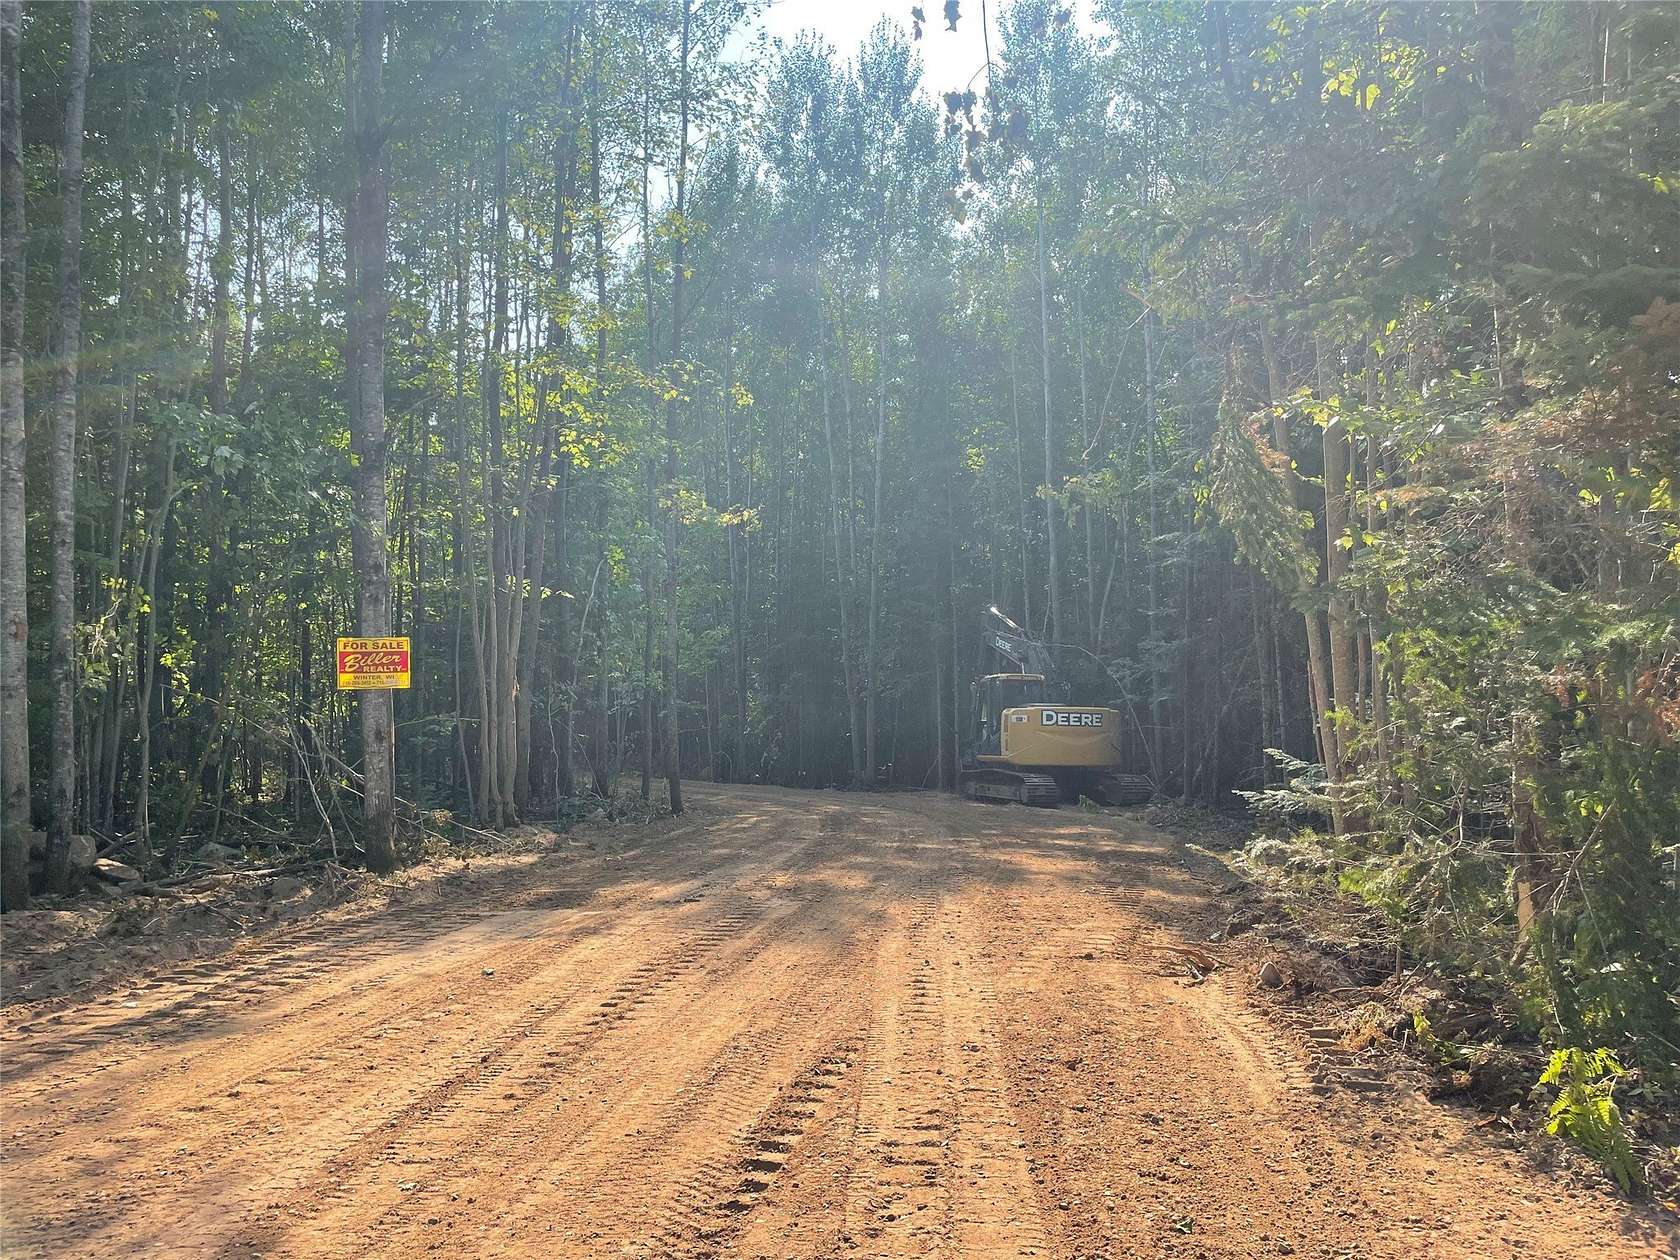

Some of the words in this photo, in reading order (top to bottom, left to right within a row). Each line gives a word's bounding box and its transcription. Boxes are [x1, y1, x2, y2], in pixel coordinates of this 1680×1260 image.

[343, 642, 368, 650] FOR
[372, 641, 404, 650] SALE
[995, 636, 1012, 652] DEERE
[343, 652, 401, 672] Biller
[363, 665, 402, 673] REALTY
[1042, 710, 1102, 726] DEERE
